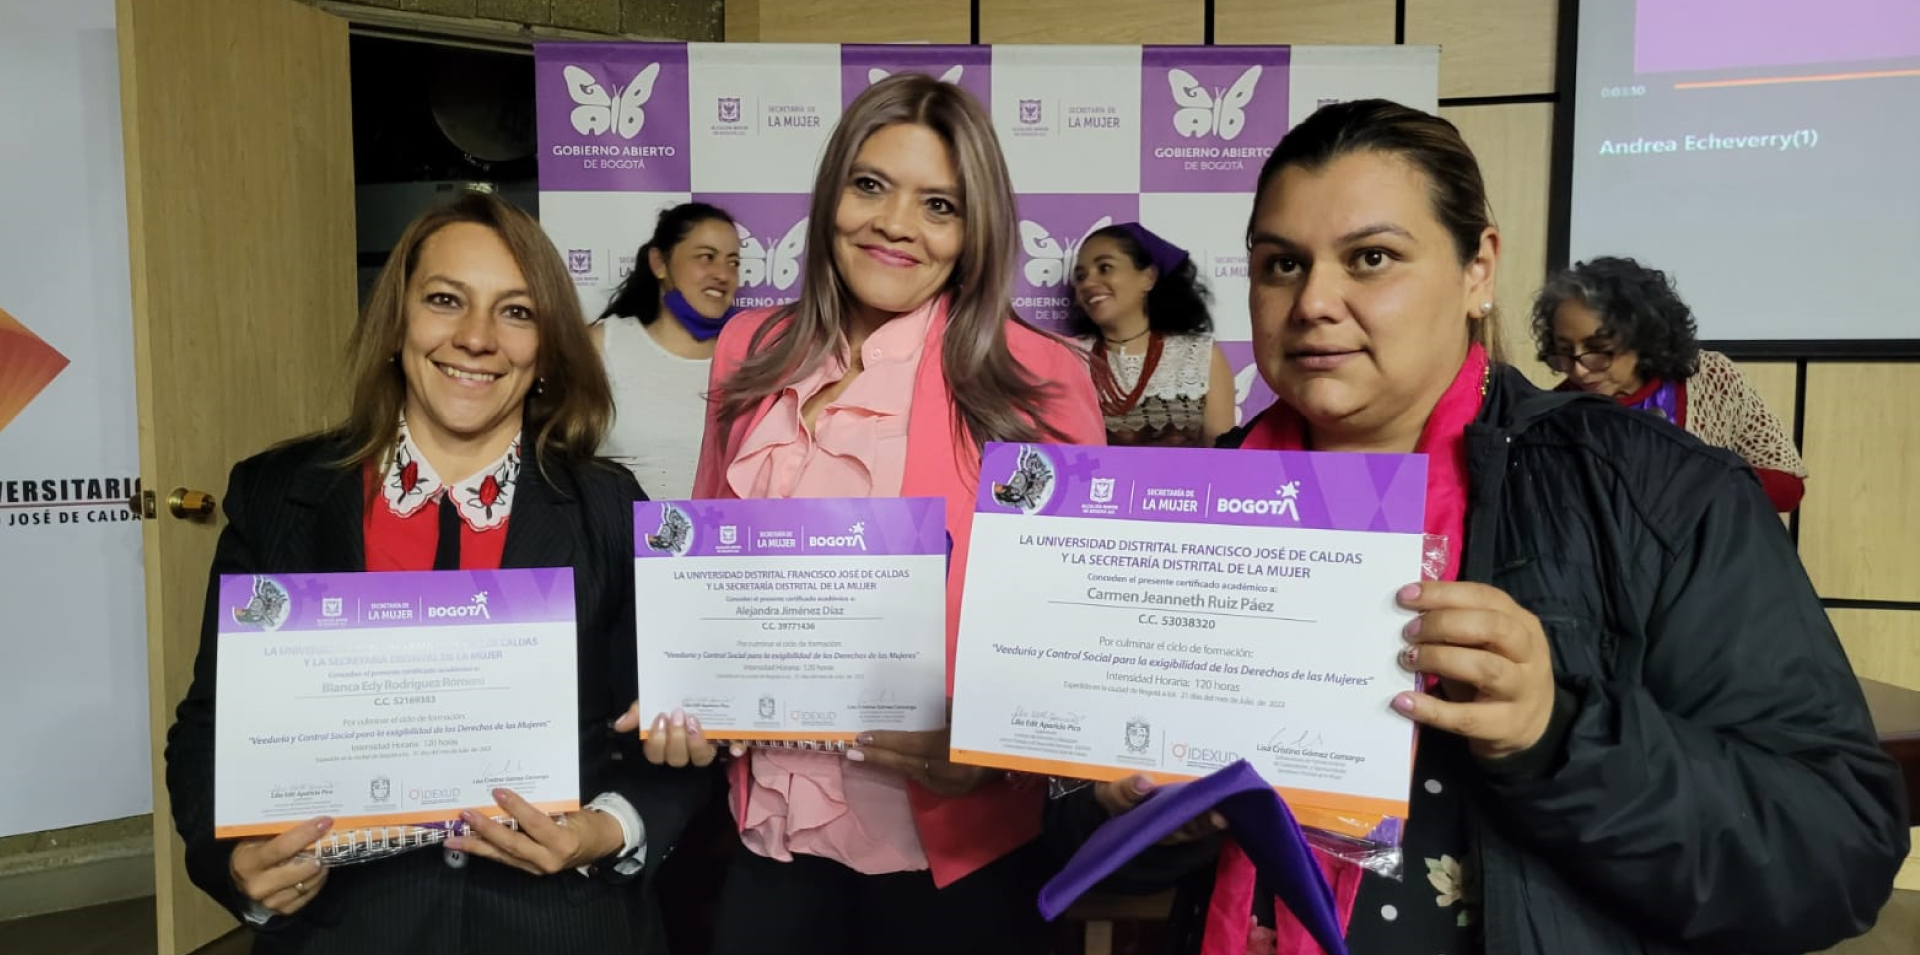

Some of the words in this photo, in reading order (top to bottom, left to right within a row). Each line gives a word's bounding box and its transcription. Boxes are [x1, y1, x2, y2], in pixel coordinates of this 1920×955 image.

[768, 116, 781, 127] LA
[784, 116, 820, 127] MUJER
[1069, 117, 1081, 128] LA
[1084, 117, 1120, 128] MUJER
[1600, 138, 1677, 155] Andrea
[1685, 129, 1818, 153] Echeverry(1)
[553, 145, 619, 157] GOBIERNO
[622, 145, 675, 157] ABIERTO
[1154, 147, 1219, 158] GOBIERNO
[584, 159, 598, 169] DE
[601, 157, 645, 169] BOGOTÁ
[1185, 161, 1199, 170] DE
[1201, 159, 1244, 171] BOGOTÁ
[1036, 310, 1050, 320] DE
[1146, 487, 1182, 497] SECRETARÍA
[1184, 488, 1196, 497] DE
[1141, 497, 1157, 511] LA
[1158, 498, 1199, 513] MUJER
[9, 509, 51, 526] JOSÉ
[59, 511, 79, 523] DE
[757, 539, 766, 548] LA
[767, 538, 795, 548] MUJER
[1019, 535, 1033, 545] LA
[1036, 536, 1116, 550] UNIVERSIDAD
[1118, 540, 1177, 553] DISTRITAL
[1181, 543, 1252, 557] FRANCISCO
[1255, 544, 1286, 559] JOSÉ
[1288, 549, 1306, 560] DE
[1309, 550, 1363, 563] CALDAS
[1061, 553, 1068, 564] Y
[1071, 554, 1085, 565] LA
[1088, 553, 1160, 569] SECRETARÍA
[1162, 559, 1225, 573] DISTRITAL
[1227, 562, 1244, 574] DE
[1246, 563, 1263, 575] LA
[1266, 564, 1311, 578] MUJER
[674, 571, 684, 579] LA
[686, 571, 743, 579] UNIVERSIDAD
[744, 570, 785, 579] DISTRITAL
[787, 570, 835, 578] FRANCISCO
[861, 569, 873, 578] DE
[875, 569, 909, 577] CALDAS
[706, 583, 711, 591] Y
[713, 583, 724, 591] LA
[775, 582, 816, 590] DISTRITAL
[820, 582, 832, 590] DE
[834, 582, 844, 590] LA
[1086, 573, 1127, 583] Conceden
[1128, 575, 1136, 583] el
[1138, 576, 1174, 587] presente
[1175, 578, 1219, 588] certificado
[1221, 581, 1267, 591] académico
[1086, 587, 1139, 603] Carmen
[1141, 591, 1204, 608] Jeanneth
[1208, 595, 1238, 610] Ruiz
[1240, 597, 1275, 613] Páez
[368, 610, 379, 620] LA
[381, 609, 412, 620] MUJER
[735, 606, 779, 617] Alejandra
[781, 606, 821, 615] Jiménez
[822, 606, 844, 614] Díaz
[761, 622, 775, 630] C.C.
[1138, 613, 1158, 625] C.C.
[1161, 615, 1215, 629] 53038320
[501, 637, 537, 646] CALDAS
[1098, 636, 1114, 648] Por
[1115, 637, 1154, 651] culminar
[1156, 640, 1165, 652] el
[1166, 641, 1187, 654] ciclo
[1188, 643, 1201, 655] de
[1203, 644, 1254, 659] formación:
[1036, 649, 1044, 659] y
[1045, 647, 1081, 661] Control
[1083, 650, 1111, 663] Social
[1112, 655, 1135, 668] para
[1137, 655, 1147, 666] la
[1148, 656, 1207, 671] exigibilidad
[1208, 660, 1222, 673] de
[1224, 662, 1238, 674] los
[1240, 663, 1289, 678] Derechos
[1290, 667, 1305, 680] de
[1306, 668, 1322, 681] las
[322, 681, 359, 692] Blanca
[362, 680, 381, 692] Edy
[1106, 670, 1153, 684] Intensidad
[1154, 674, 1189, 688] Horaria:
[1195, 678, 1212, 690] 120
[1213, 679, 1241, 692] horas
